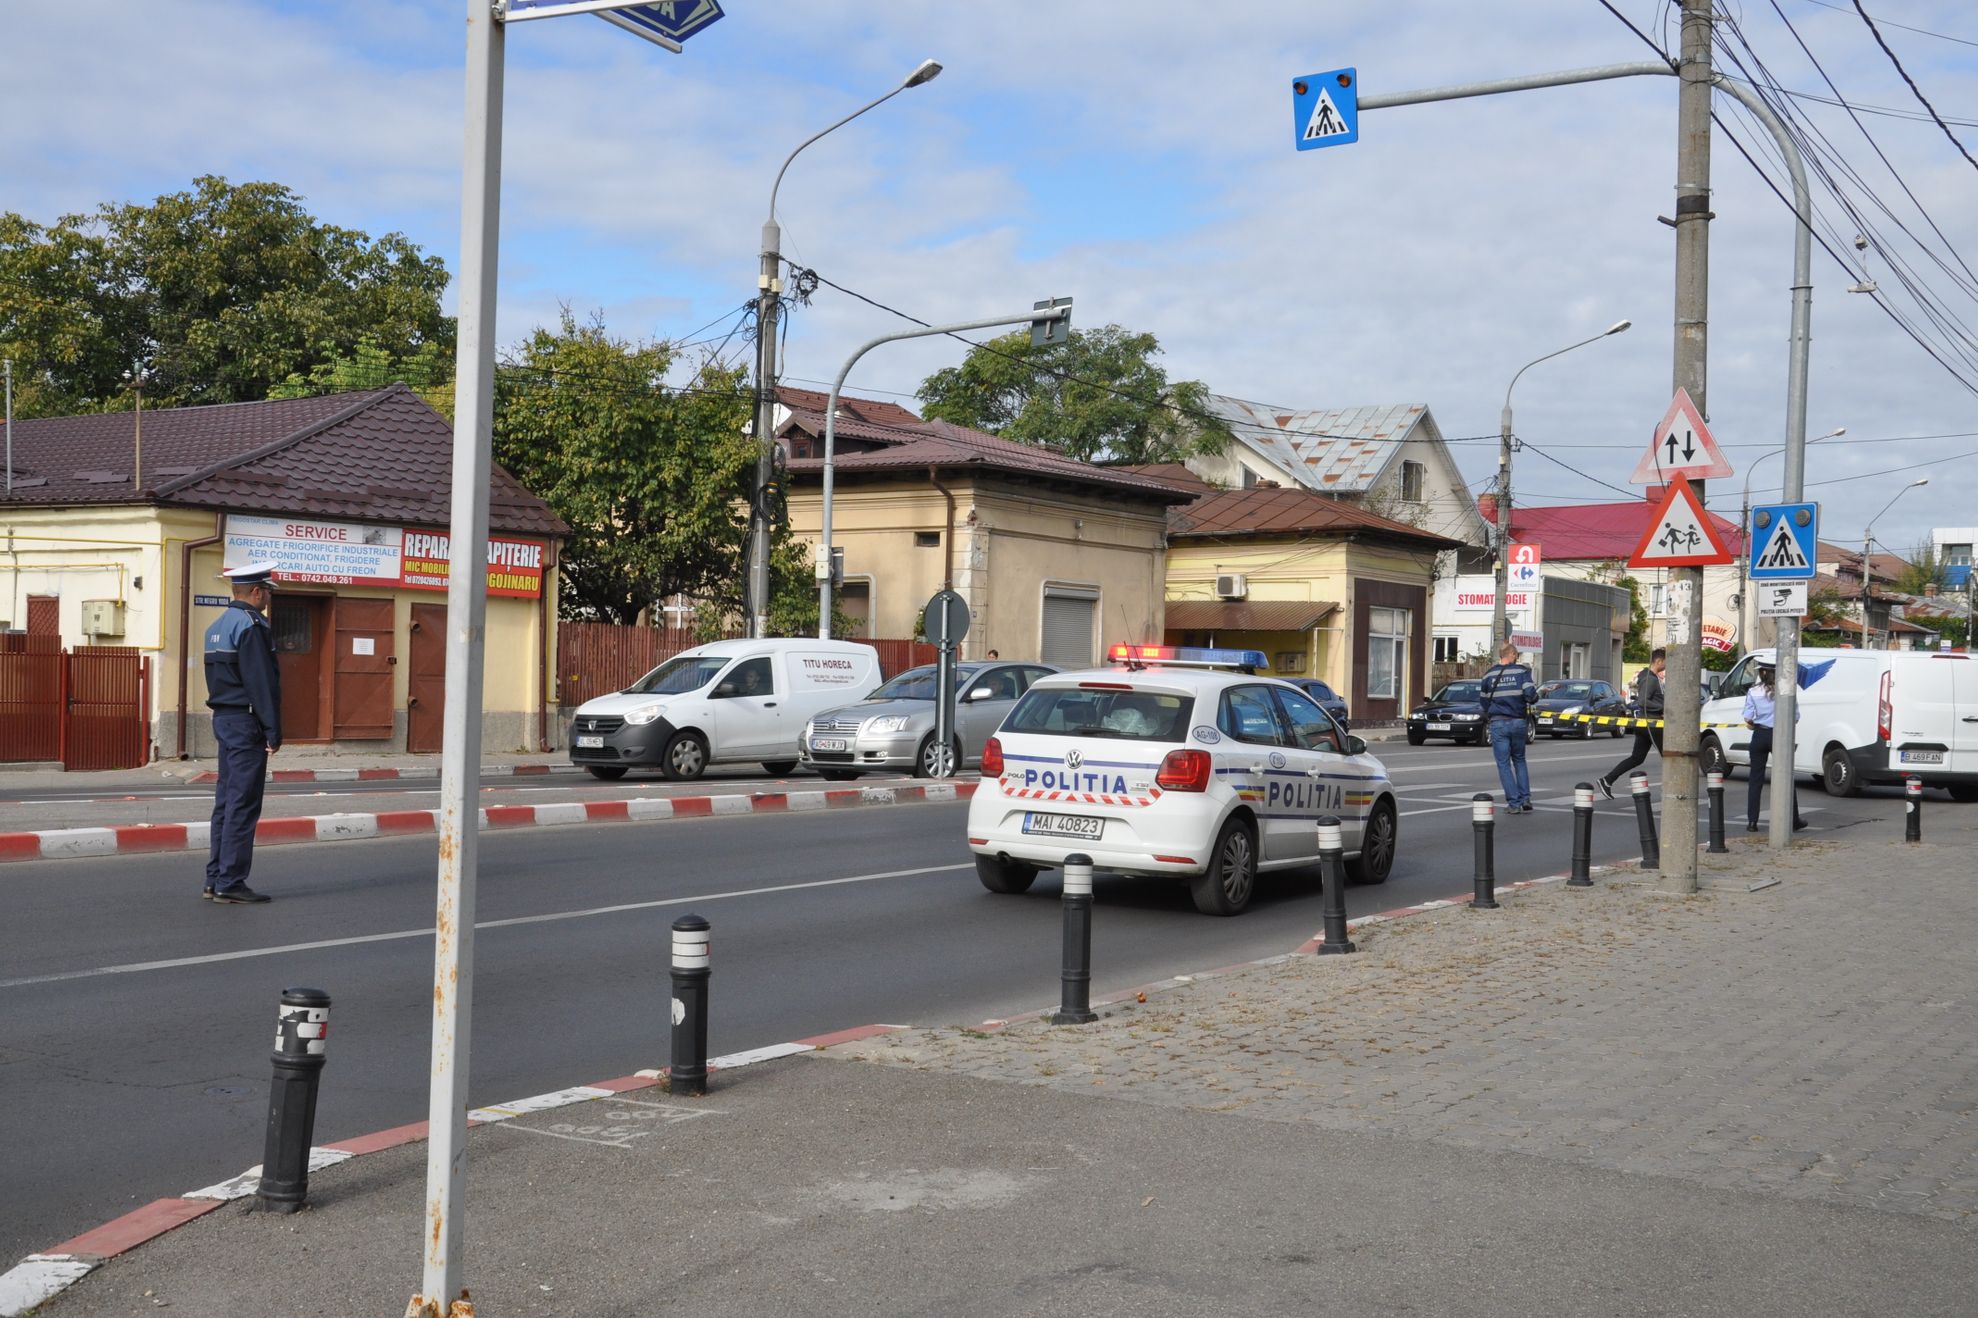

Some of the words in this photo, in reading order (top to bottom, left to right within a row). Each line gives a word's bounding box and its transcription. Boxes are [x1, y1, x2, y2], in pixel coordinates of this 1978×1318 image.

[285, 524, 347, 540] SERVICE
[228, 537, 280, 549] AGREGATE
[282, 541, 339, 553] FRIGORIFICE
[341, 545, 398, 557] INDUSTRIALE
[247, 549, 267, 558] AER
[334, 554, 381, 565] FRIGIDERE
[251, 559, 303, 571] INRCARI
[304, 562, 330, 573] AUTO
[331, 564, 345, 574] CU
[346, 565, 377, 575] FREON
[404, 560, 421, 573] MIC
[277, 572, 300, 582] TEL.:
[301, 573, 353, 586] 0742.049.261
[1457, 593, 1528, 605] STOMATOGIE
[1702, 624, 1728, 637] ETARIE
[802, 658, 821, 669] TITU
[822, 660, 853, 670] HORECA
[1905, 753, 1911, 761] B
[1025, 768, 1128, 794] POLITIA
[1268, 781, 1341, 809] POLITIA
[1032, 815, 1054, 830] MAI
[1057, 816, 1099, 833] 40823
